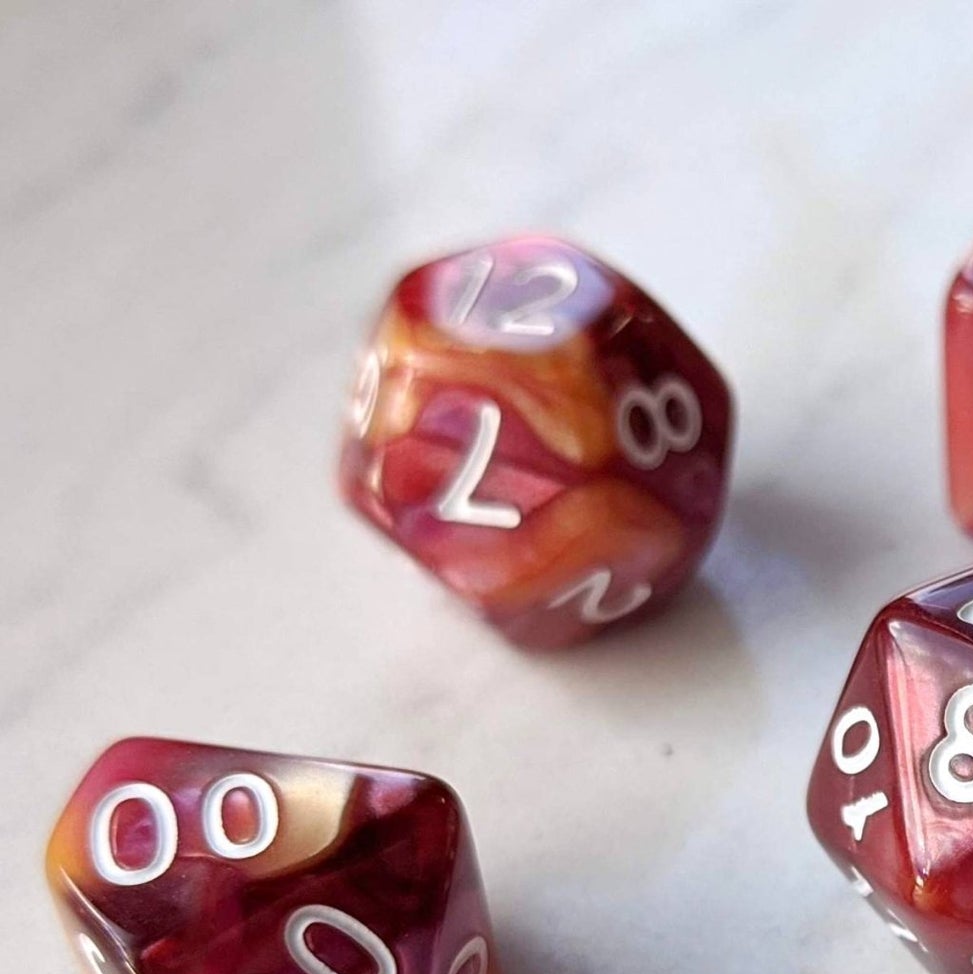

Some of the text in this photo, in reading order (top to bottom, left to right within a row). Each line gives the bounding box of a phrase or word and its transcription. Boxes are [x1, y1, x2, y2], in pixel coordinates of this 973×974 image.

[450, 252, 579, 336] 12
[438, 402, 521, 529] 7
[616, 376, 702, 469] 8
[546, 567, 652, 624] 2
[831, 706, 889, 841] 10
[90, 772, 279, 886] 00
